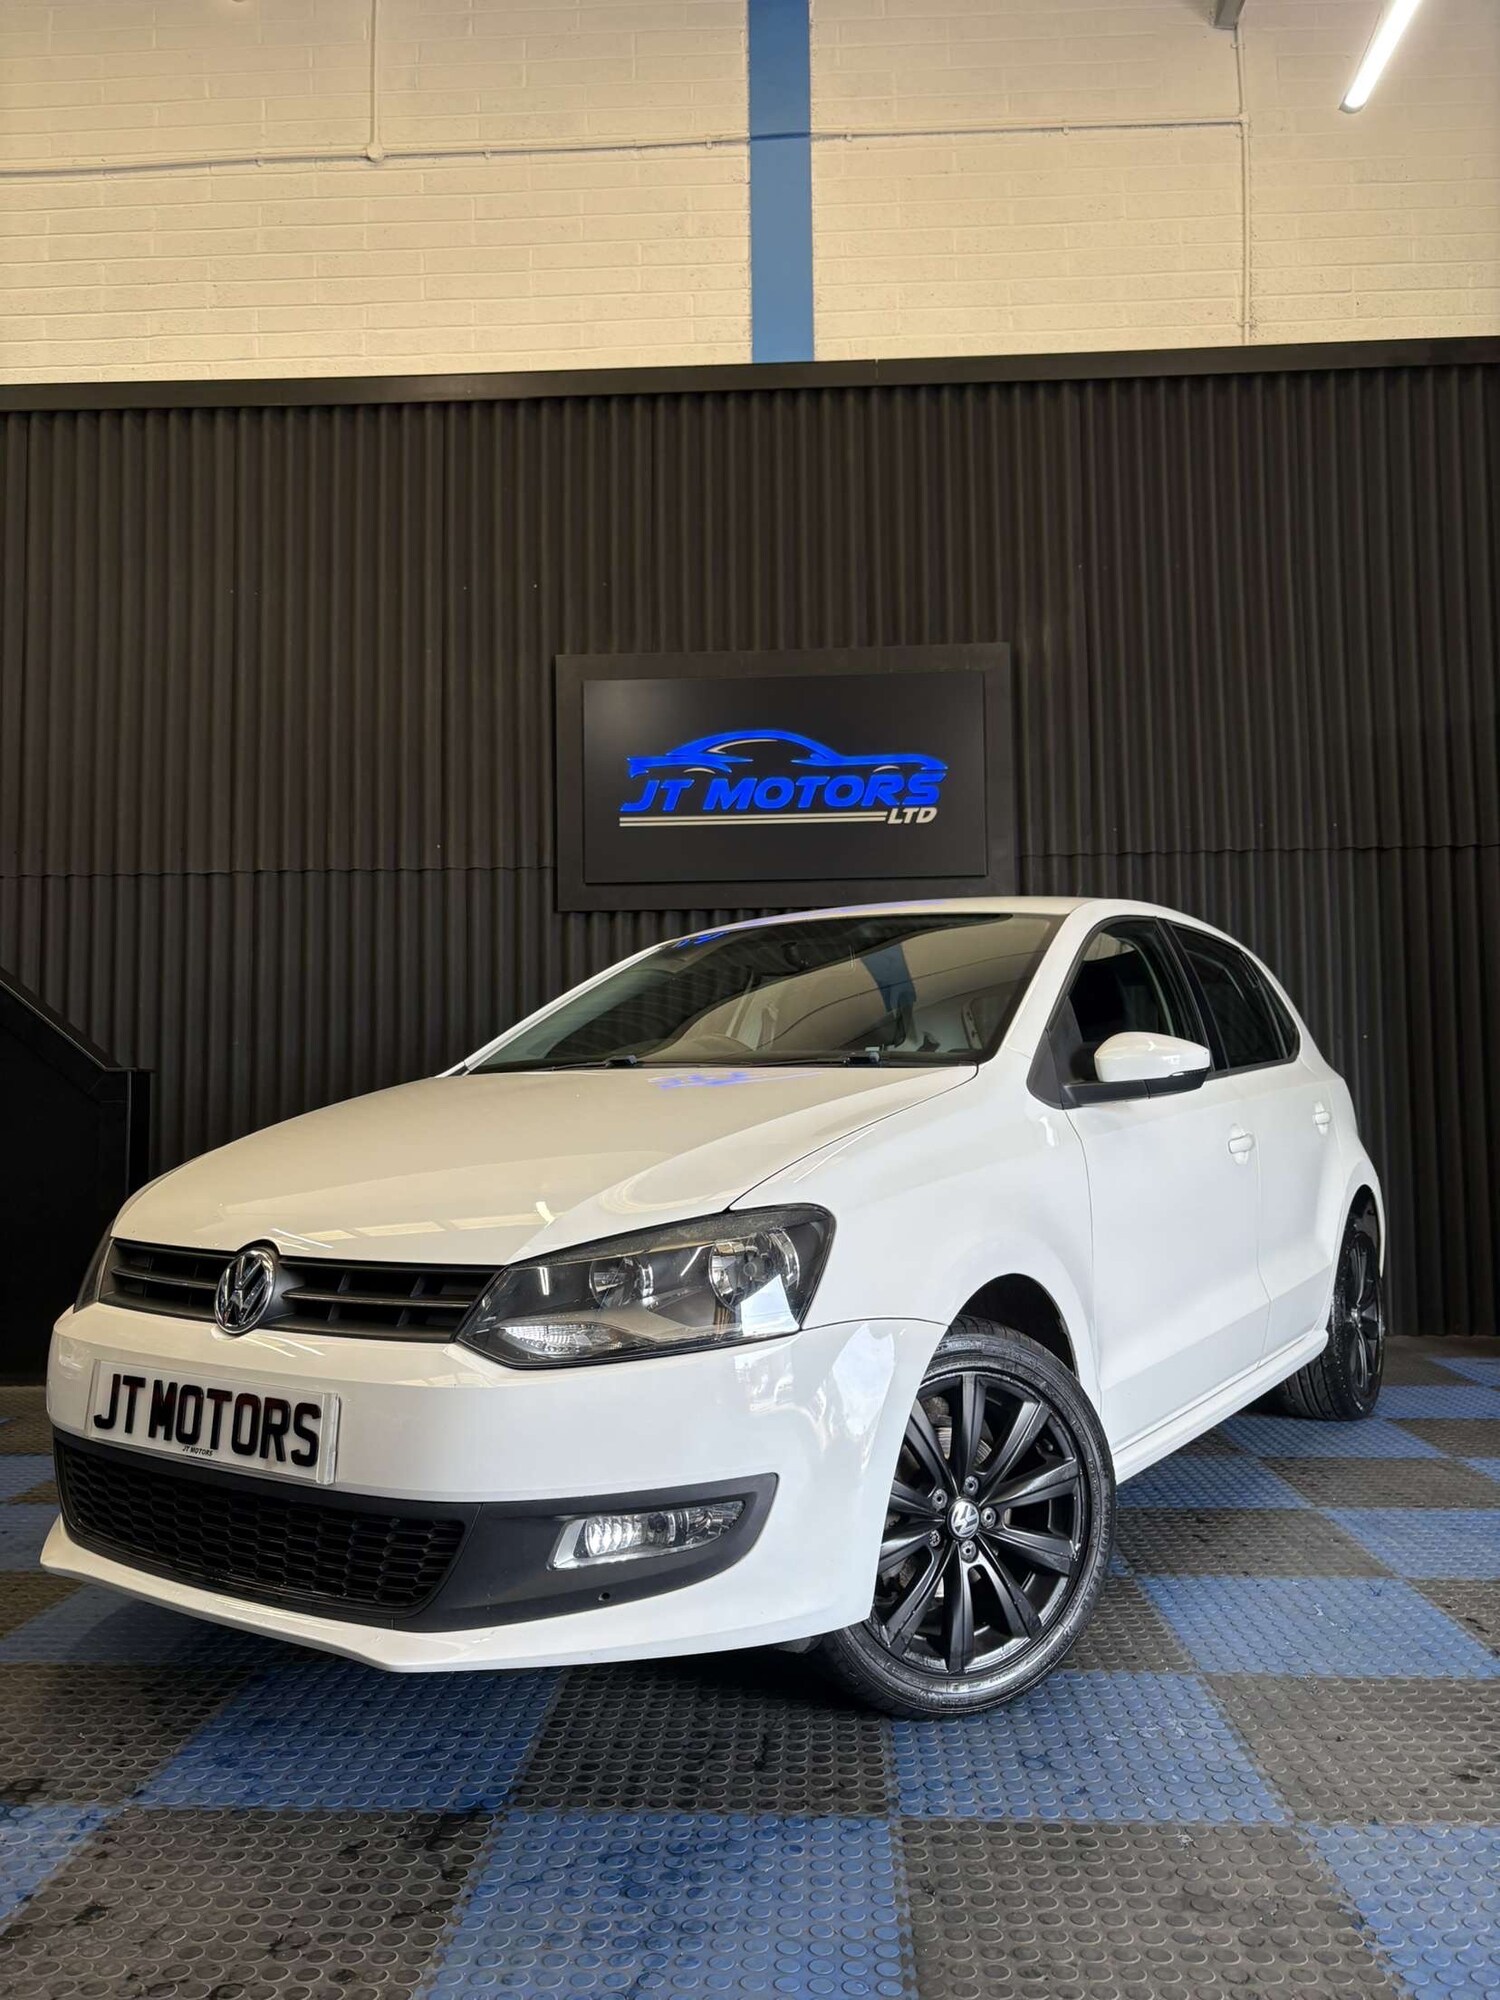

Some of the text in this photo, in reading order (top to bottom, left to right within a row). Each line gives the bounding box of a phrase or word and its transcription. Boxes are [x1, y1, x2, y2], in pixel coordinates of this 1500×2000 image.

[620, 773, 946, 812] JT MOTORS
[887, 807, 938, 825] LTD
[93, 1373, 322, 1468] JT MOTORS
[190, 1446, 214, 1457] MOTORS
